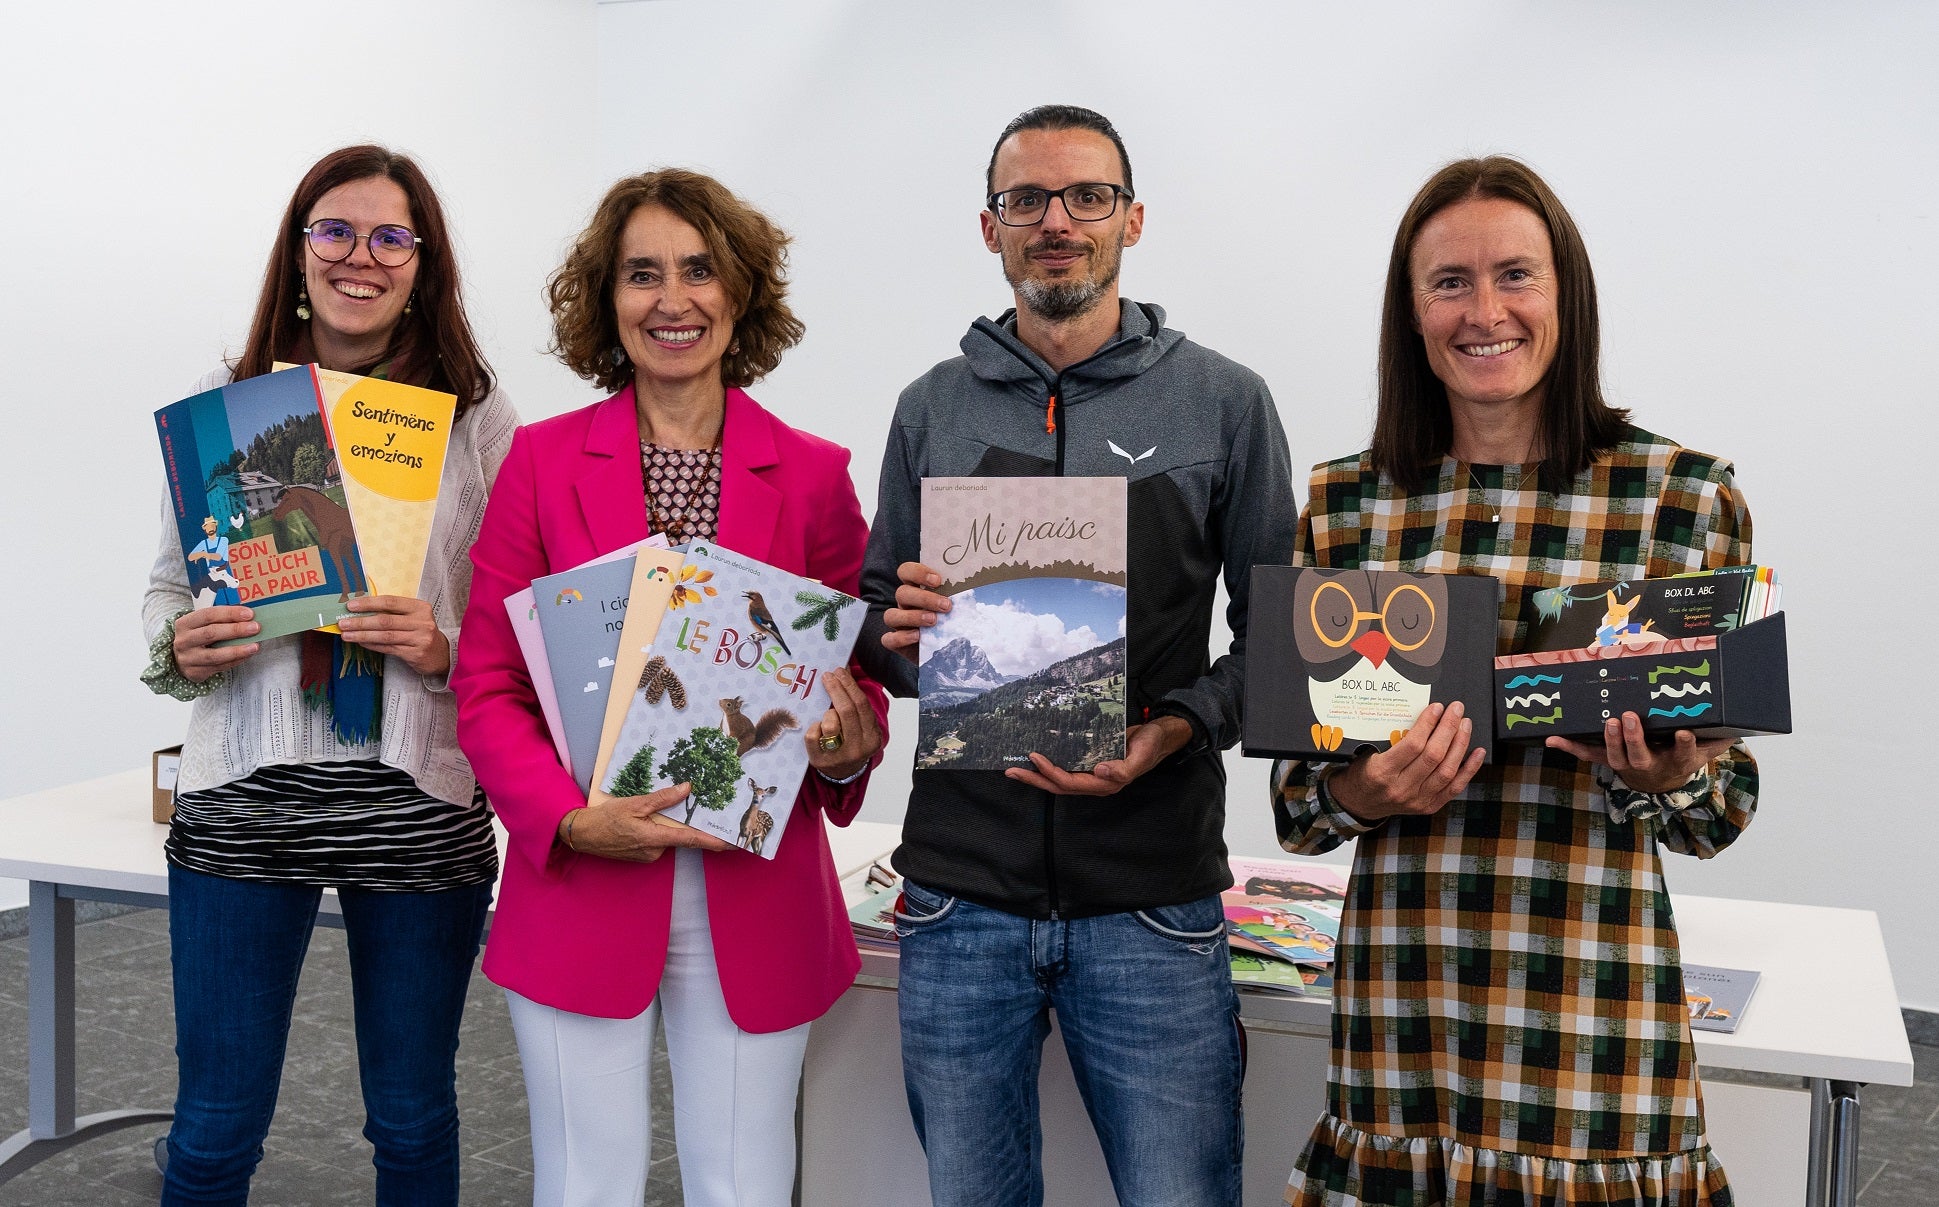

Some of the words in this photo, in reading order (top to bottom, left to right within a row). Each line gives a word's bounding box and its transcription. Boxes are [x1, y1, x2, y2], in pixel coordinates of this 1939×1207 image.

[352, 400, 435, 432] Sentimënc
[384, 432, 396, 446] y
[351, 444, 423, 468] emozions
[943, 513, 1006, 565] Mi
[1010, 516, 1096, 556] paisc
[228, 541, 268, 563] SÖN
[233, 564, 254, 581] LE
[257, 552, 308, 576] LÜCH
[711, 553, 730, 565] Laurun
[732, 560, 761, 576] deboriada
[237, 582, 264, 601] DA
[268, 570, 320, 594] PAUR
[1665, 588, 1682, 598] BOX
[1684, 588, 1695, 596] DL
[1698, 586, 1715, 595] ABC
[675, 617, 710, 654] LE
[712, 627, 818, 700] BOSCH
[1342, 679, 1362, 690] BOX
[1365, 680, 1377, 691] DL
[1381, 681, 1400, 692] ABC
